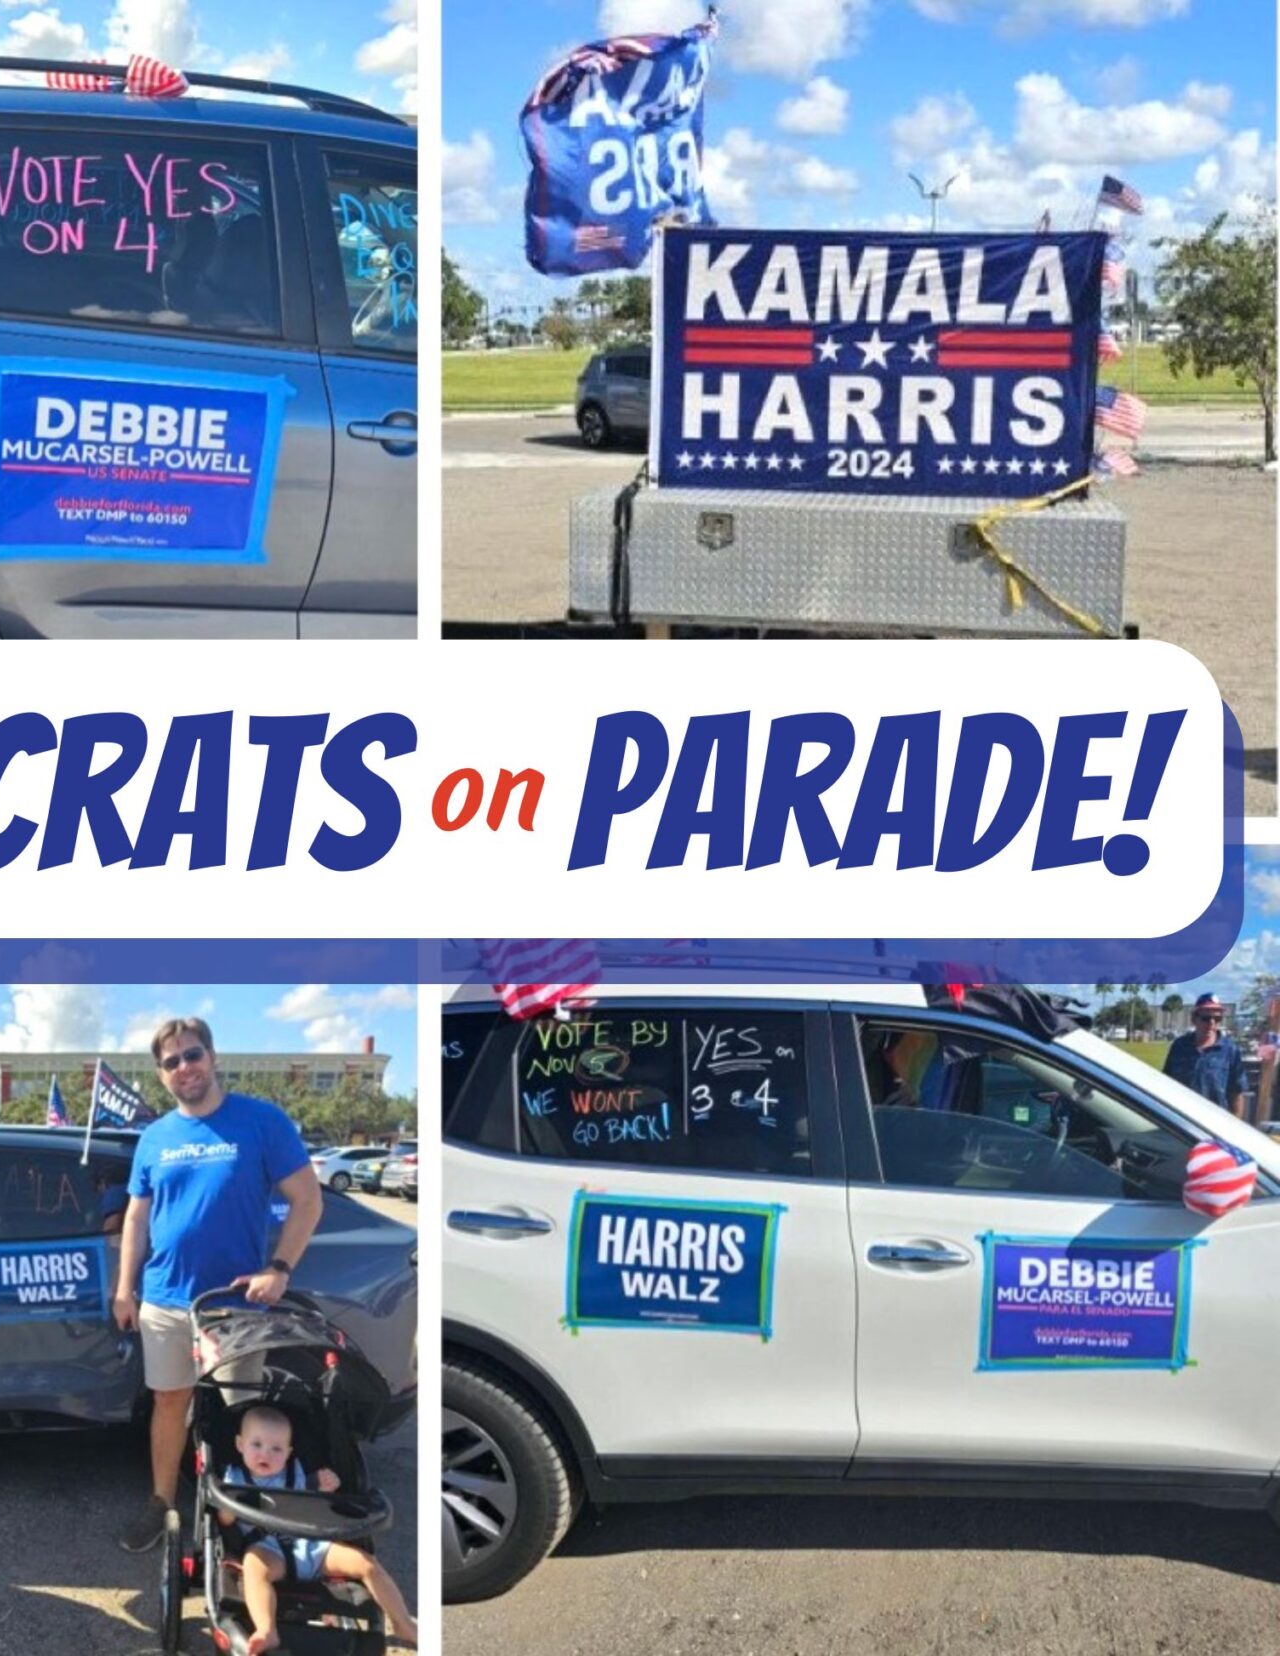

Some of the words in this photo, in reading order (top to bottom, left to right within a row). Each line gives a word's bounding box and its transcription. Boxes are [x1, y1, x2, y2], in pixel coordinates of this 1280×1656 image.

[124, 152, 236, 219] YES
[22, 217, 84, 254] ON
[114, 217, 158, 274] 4
[686, 242, 1073, 324] KAMALA
[35, 396, 228, 450] DEBBIE
[681, 372, 1066, 448] HARRIS
[0, 438, 252, 474] MUCARSEL-POWELL
[827, 450, 915, 480] 2024
[87, 467, 108, 479] US
[111, 468, 167, 482] SENATE
[54, 499, 192, 514] debbieforflorida.com
[57, 508, 92, 521] TEXT
[96, 511, 126, 522] DMP
[130, 513, 143, 523] to
[146, 514, 187, 525] 60150
[536, 1021, 612, 1050] VOTE
[631, 1020, 668, 1047] BY
[692, 1025, 762, 1071] YES
[527, 1056, 576, 1080] NOV
[522, 1088, 558, 1117] WE
[691, 1084, 715, 1113] 3
[753, 1077, 779, 1117] 4
[573, 1120, 600, 1146] GO
[597, 1214, 746, 1275] HARRIS
[1, 1252, 89, 1286] HARRIS
[1020, 1257, 1155, 1291] DEBBIE
[18, 1283, 77, 1303] WALZ
[621, 1270, 720, 1303] WALZ
[997, 1286, 1174, 1308] MUCARSEL-POWELL
[1036, 1336, 1060, 1345] TEXT
